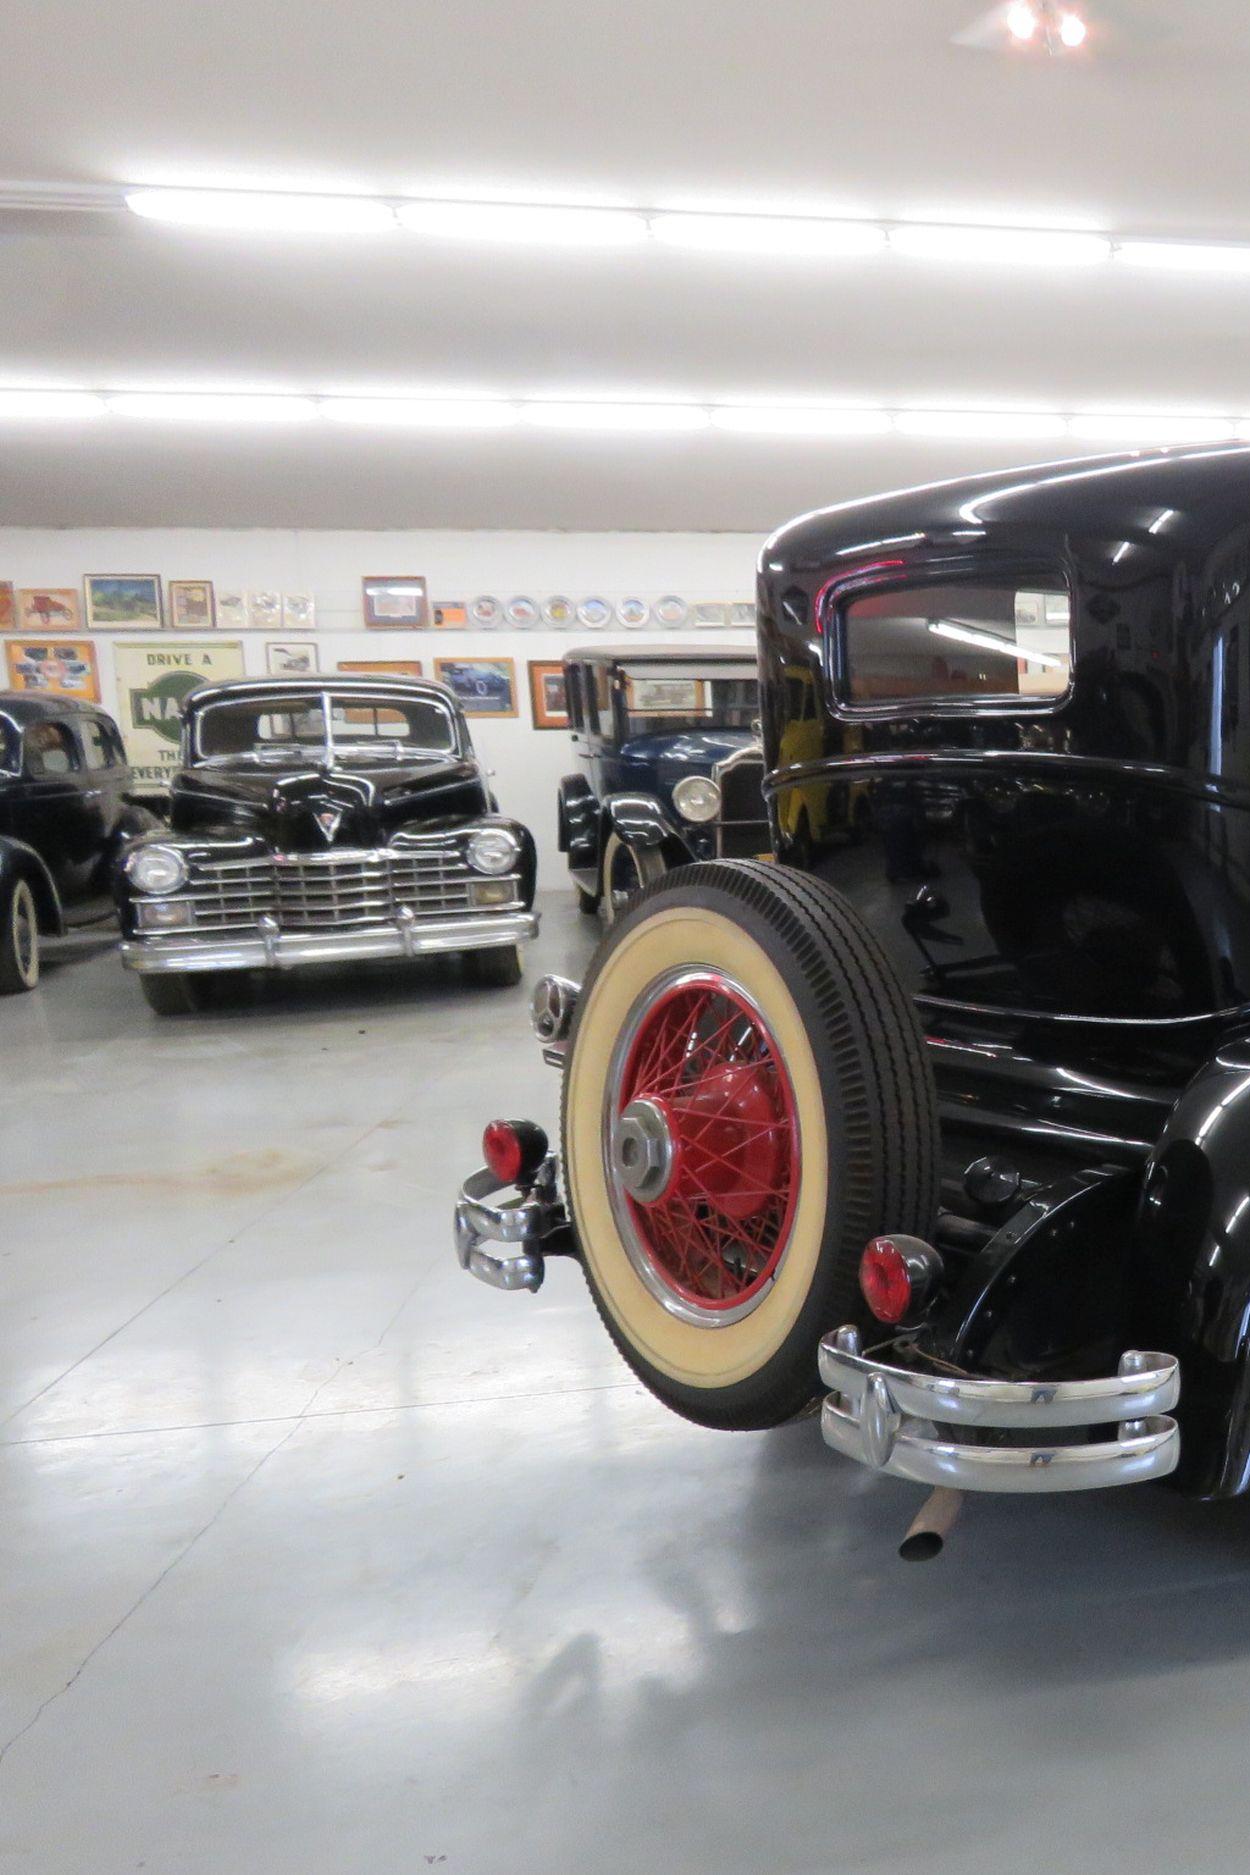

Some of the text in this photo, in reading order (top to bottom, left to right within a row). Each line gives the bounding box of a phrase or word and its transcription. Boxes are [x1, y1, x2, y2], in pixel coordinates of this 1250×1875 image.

[147, 653, 212, 665] DRIVE A
[142, 697, 183, 720] NA
[132, 766, 175, 779] EVERY
